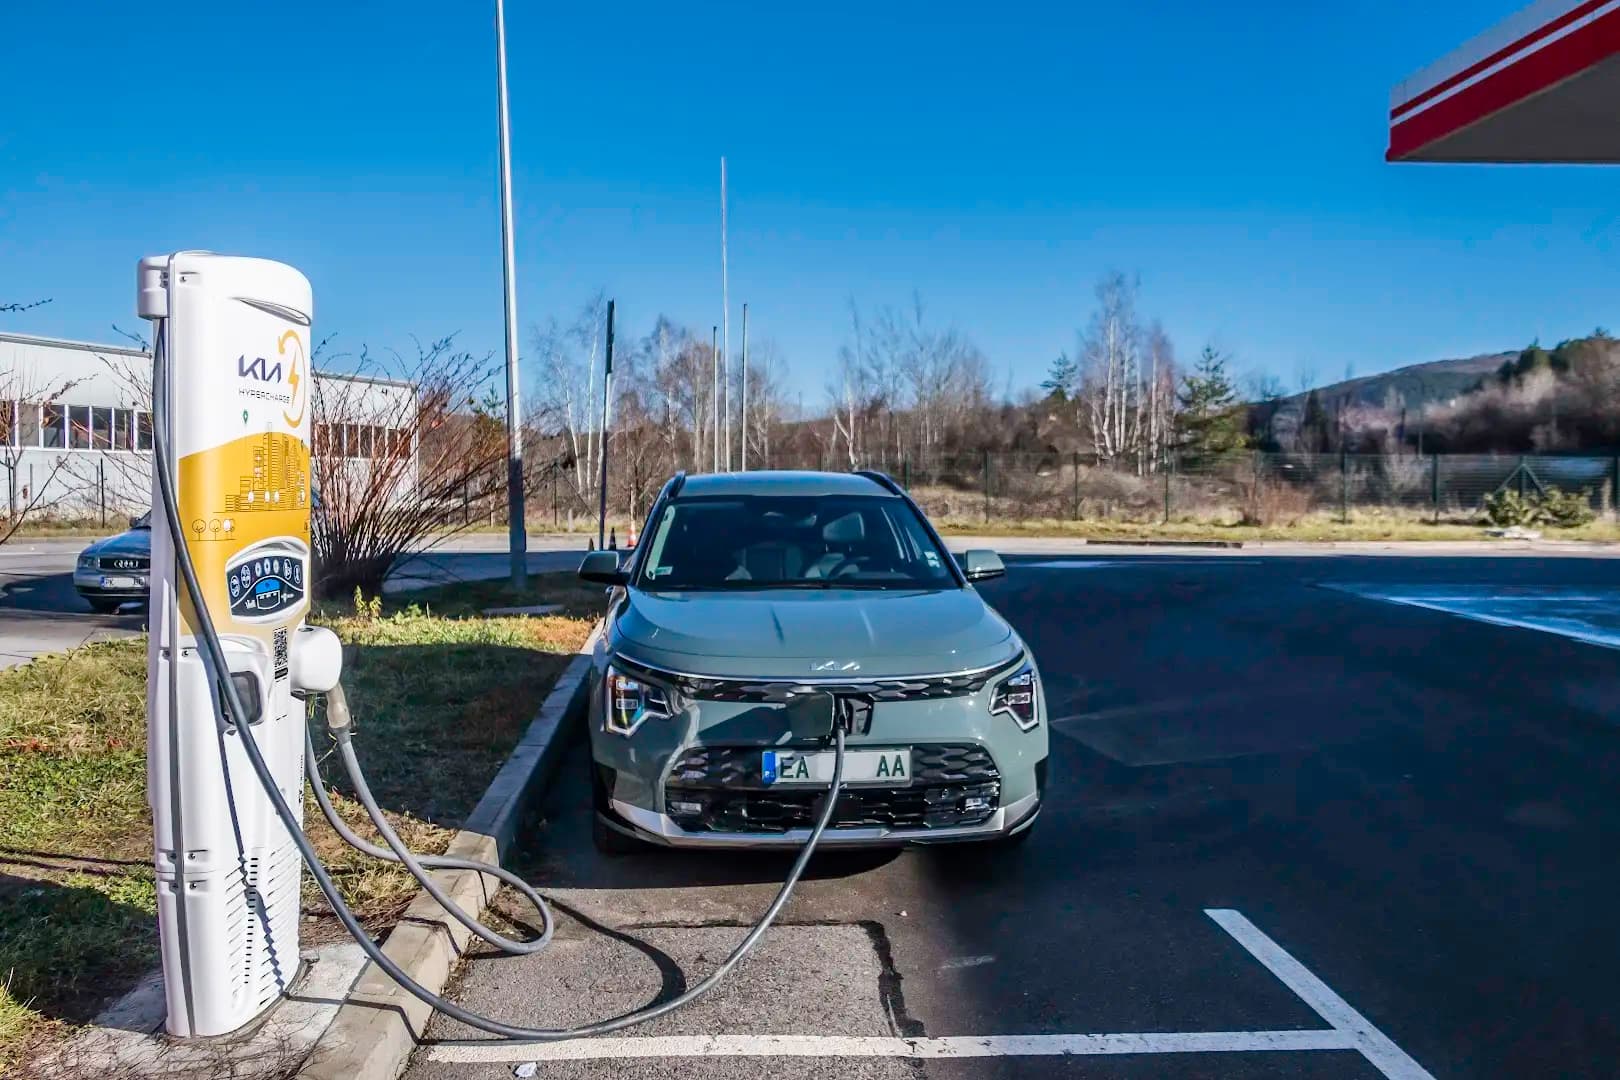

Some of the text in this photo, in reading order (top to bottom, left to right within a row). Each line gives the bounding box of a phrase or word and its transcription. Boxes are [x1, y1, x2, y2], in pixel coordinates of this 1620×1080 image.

[238, 354, 282, 383] KIA
[238, 387, 290, 404] HYPERCHARGE
[779, 754, 905, 779] EA AA
